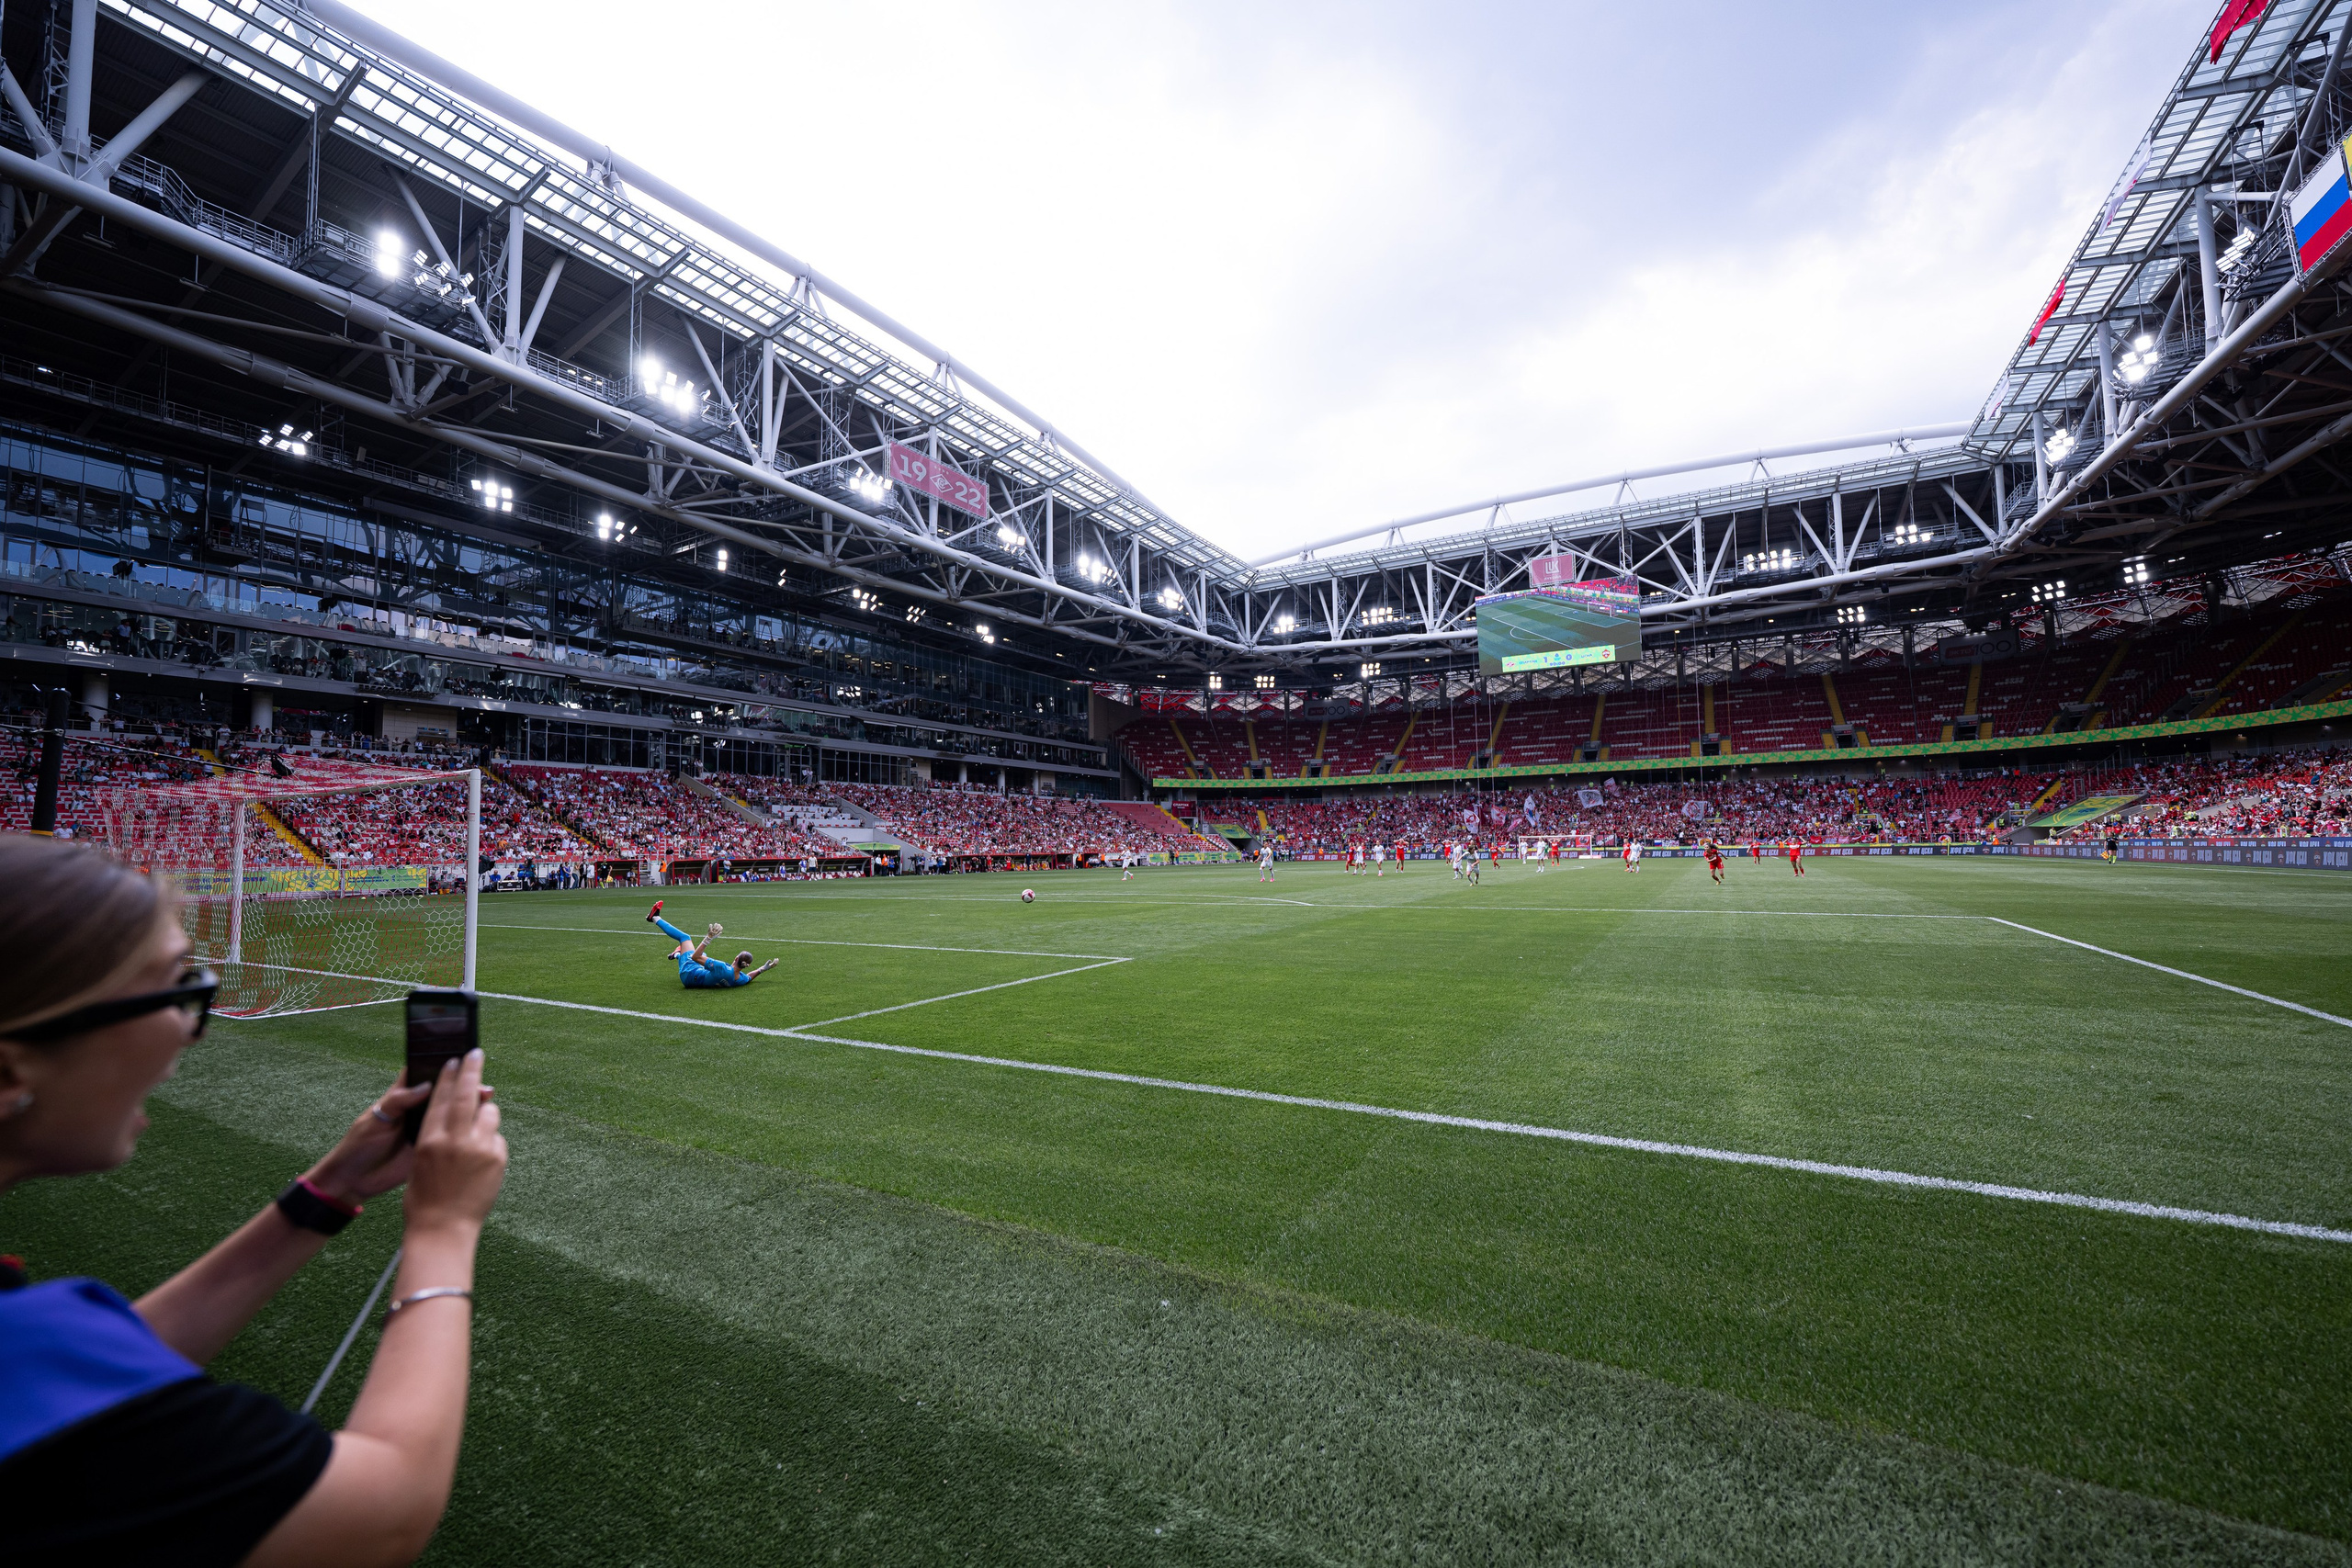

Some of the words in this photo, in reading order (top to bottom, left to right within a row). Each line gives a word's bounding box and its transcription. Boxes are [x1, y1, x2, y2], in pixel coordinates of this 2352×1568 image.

[899, 454, 927, 482] 19
[955, 481, 982, 509] 22
[1973, 640, 2011, 656] 100
